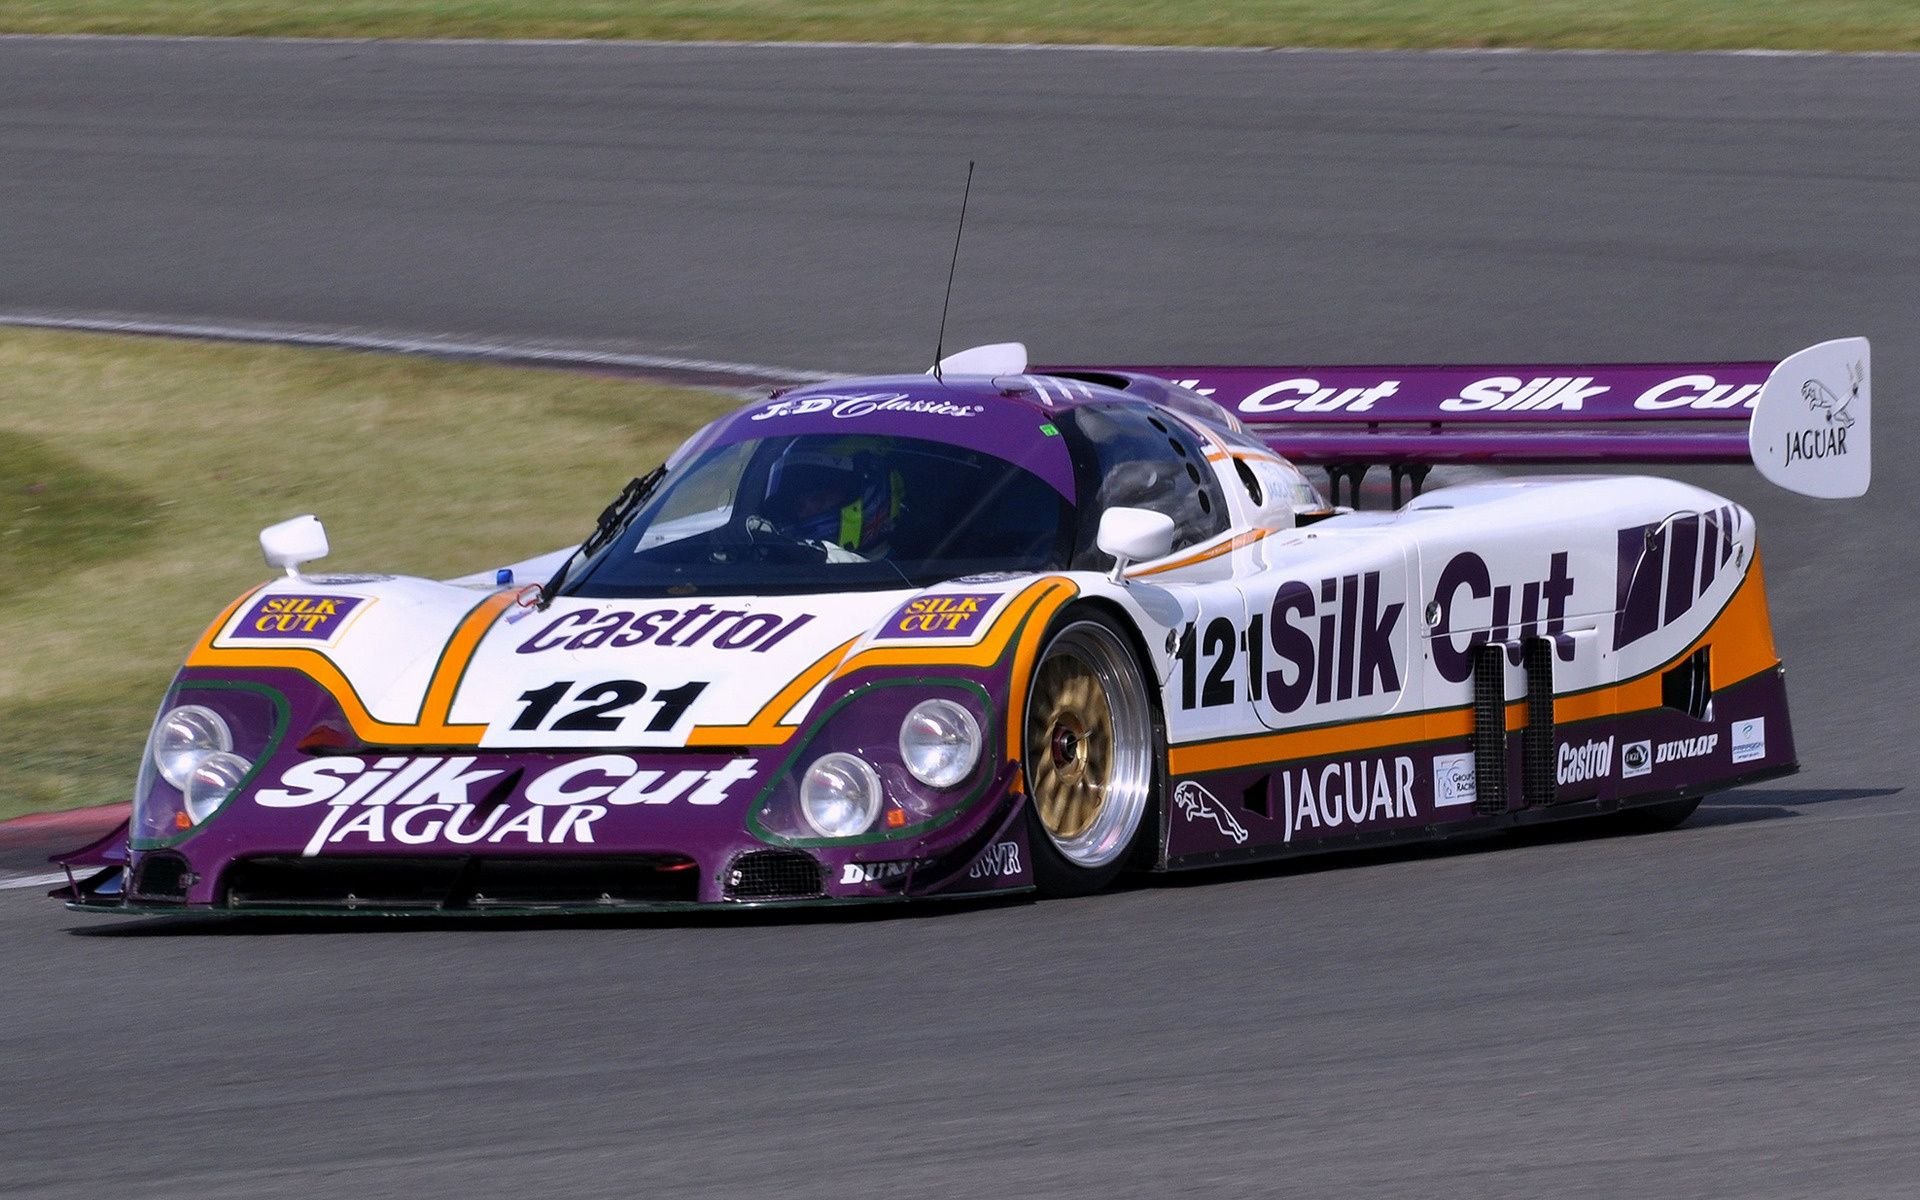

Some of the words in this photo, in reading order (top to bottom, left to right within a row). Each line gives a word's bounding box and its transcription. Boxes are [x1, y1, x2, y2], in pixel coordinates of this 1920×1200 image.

[1238, 378, 1401, 413] Cut
[1439, 376, 1611, 412] Silk
[1784, 427, 1847, 467] JAGUAR
[255, 614, 328, 633] CUT
[261, 598, 345, 616] SILK
[515, 603, 817, 654] Castrol
[899, 612, 971, 632] CUT
[904, 597, 987, 615] SILK
[1175, 613, 1263, 710] 121
[1266, 571, 1405, 714] Silk
[1431, 551, 1575, 683] Cut
[509, 679, 711, 732] 121
[1556, 735, 1615, 786] Castrol
[1655, 733, 1719, 764] DUNLOP
[254, 756, 506, 808] Silk
[524, 754, 759, 806] Cut
[1282, 756, 1418, 843] JAGUAR
[302, 803, 608, 857] JAGUAR
